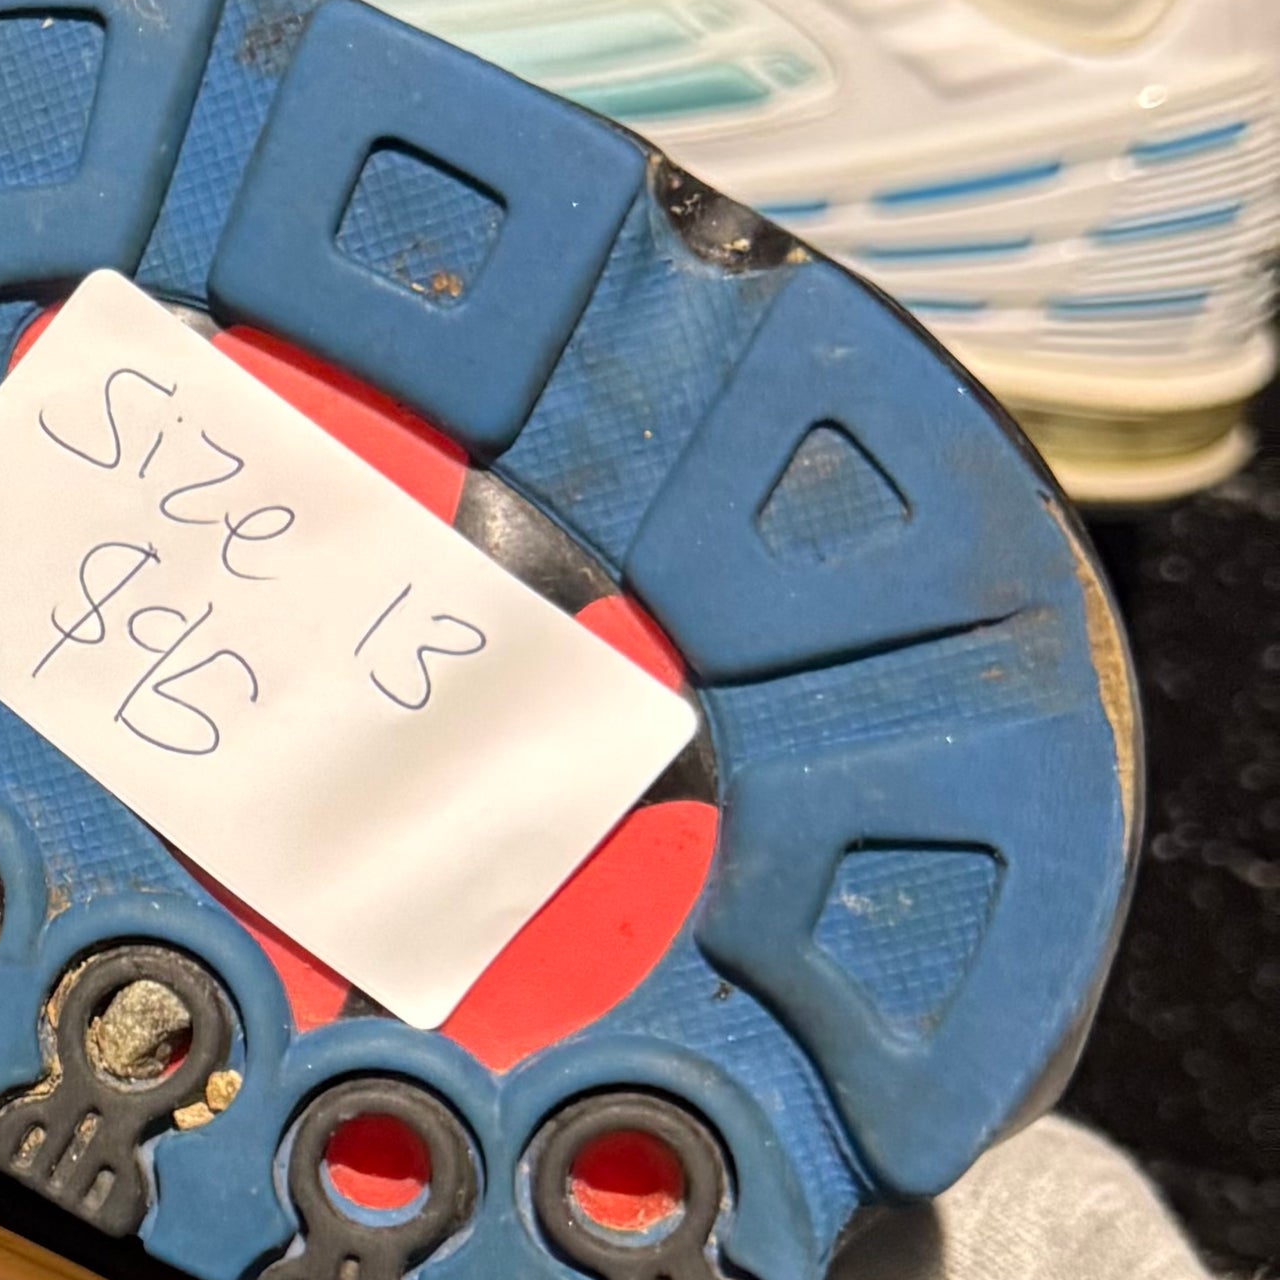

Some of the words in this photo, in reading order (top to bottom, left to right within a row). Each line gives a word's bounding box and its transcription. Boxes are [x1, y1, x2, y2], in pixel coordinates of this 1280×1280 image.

[32, 541, 260, 756] $95
[39, 367, 296, 581] Size
[354, 582, 487, 711] 13
